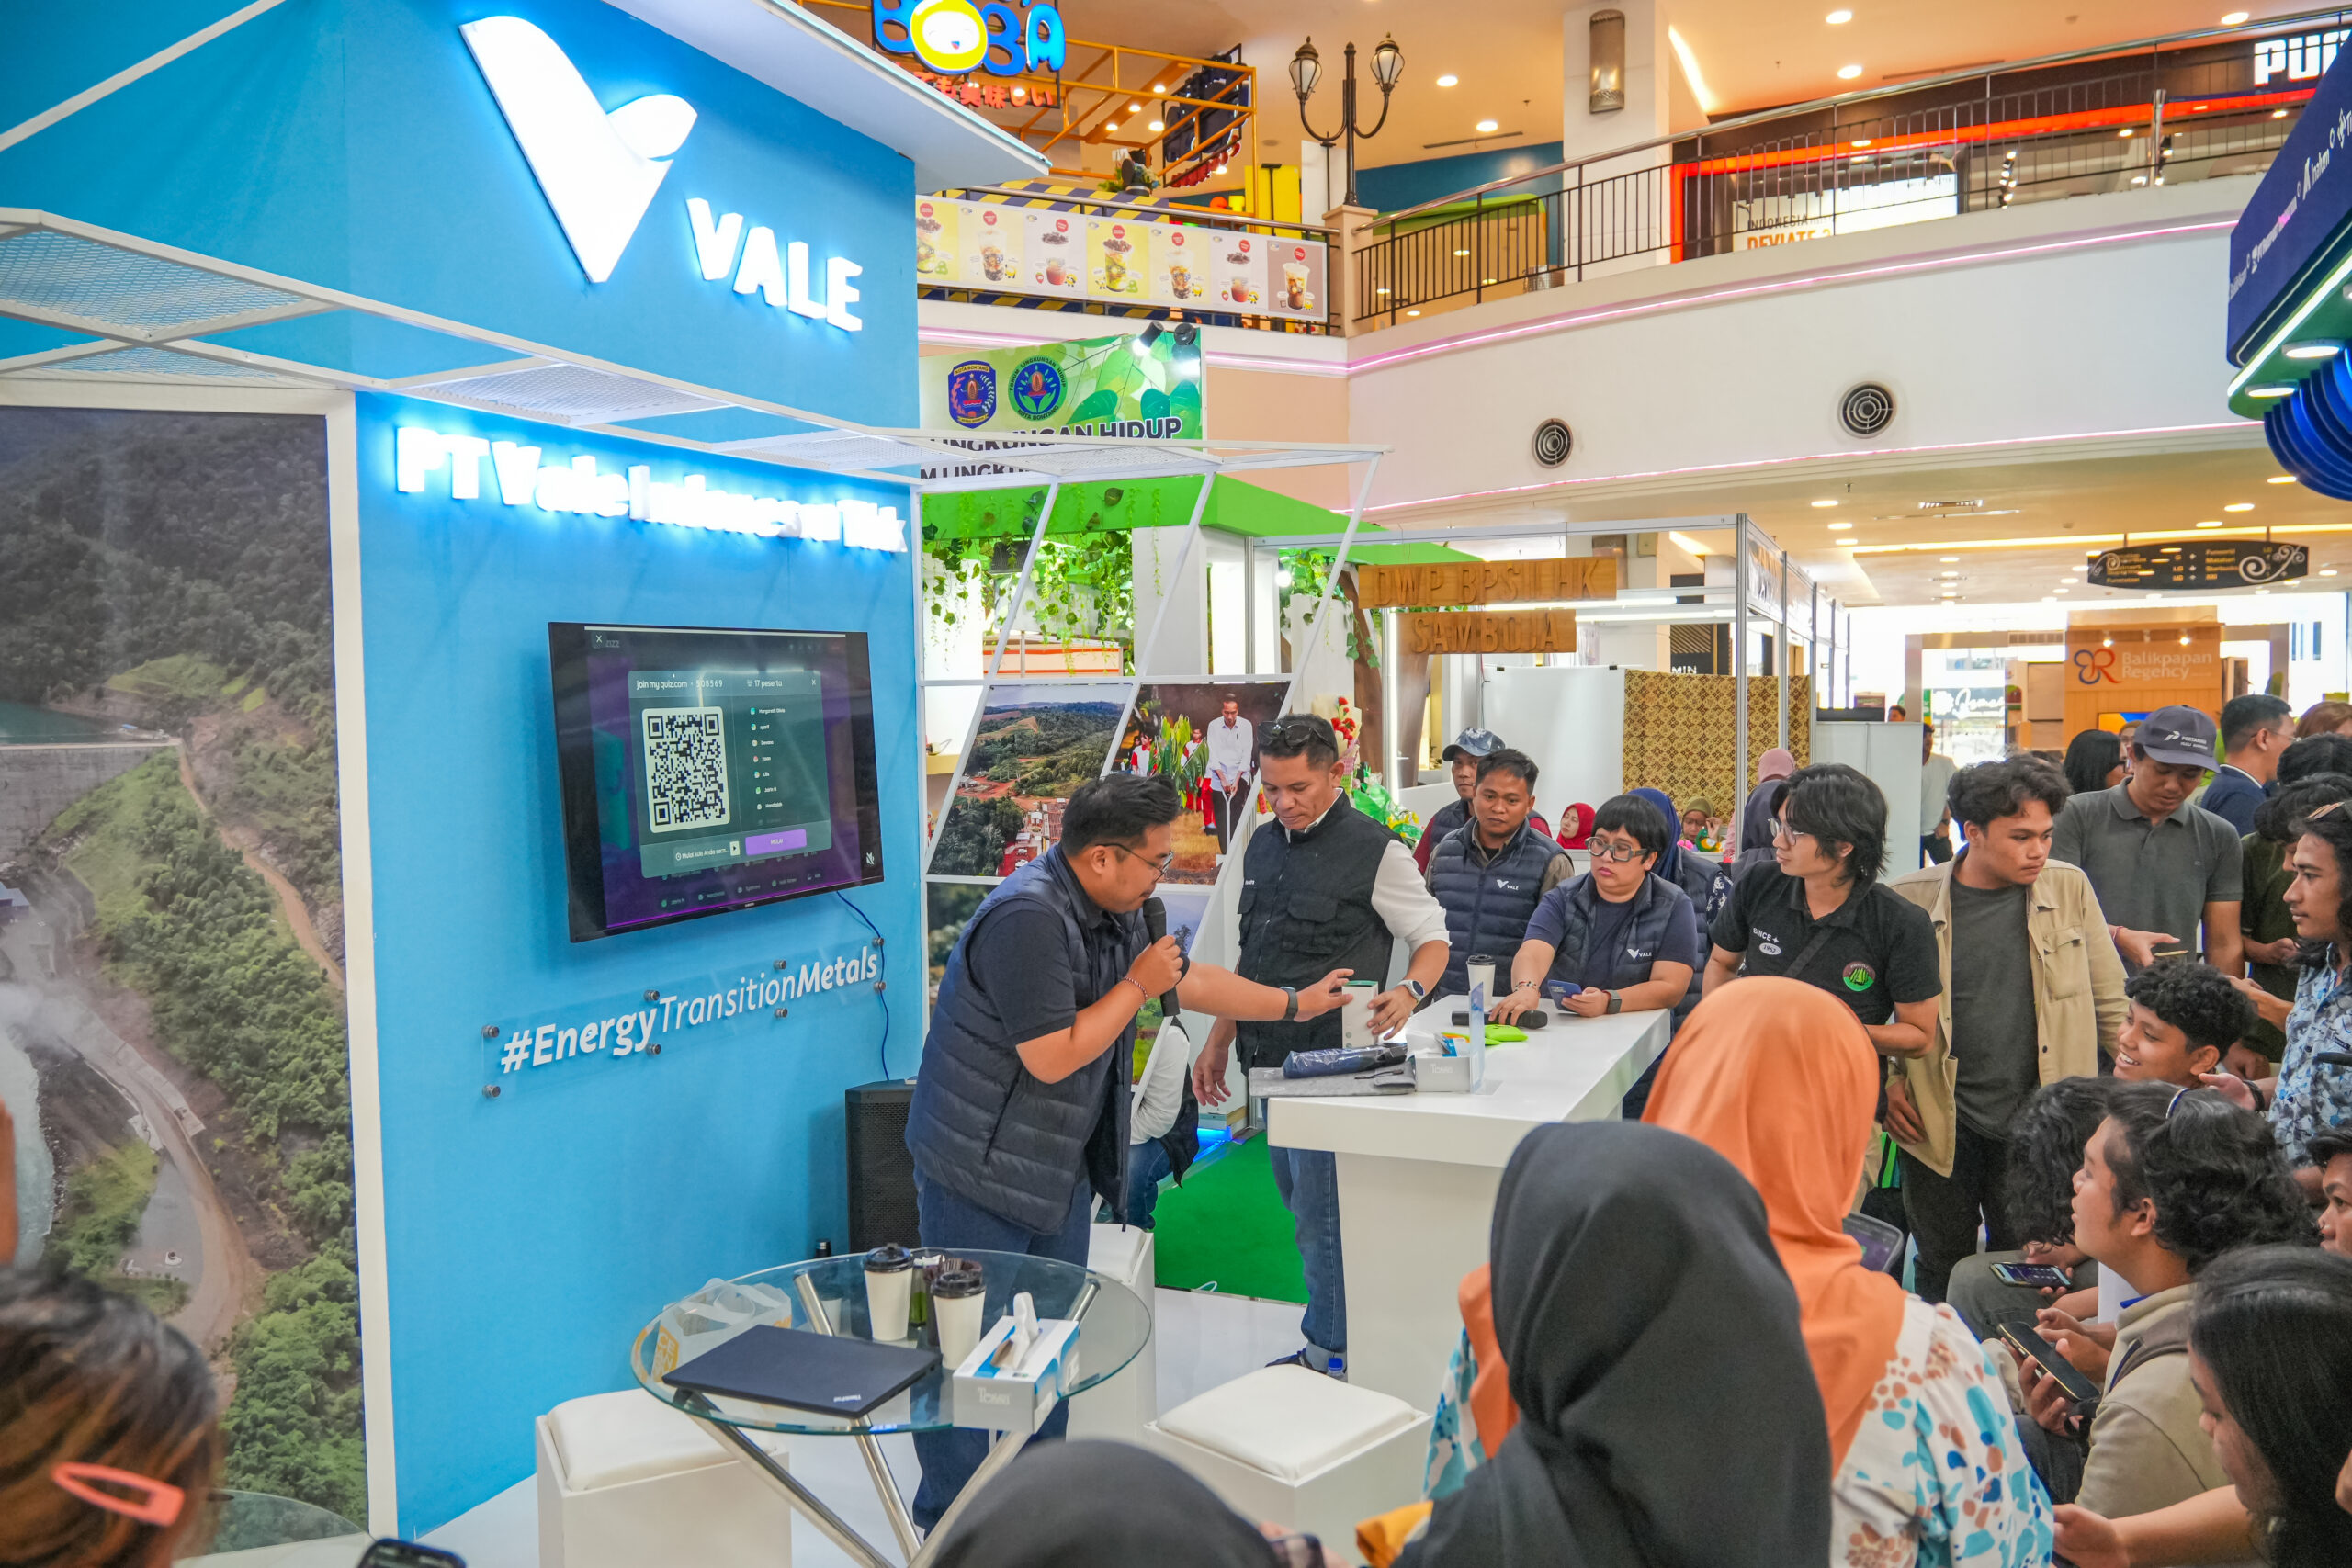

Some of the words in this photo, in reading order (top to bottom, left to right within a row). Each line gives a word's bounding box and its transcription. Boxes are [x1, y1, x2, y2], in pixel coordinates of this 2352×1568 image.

[685, 197, 864, 332] VALE
[1099, 417, 1182, 440] HIDUP
[397, 426, 490, 500] PT
[1373, 564, 1443, 607] DWP
[1411, 612, 1559, 653] SAMBOJA
[2121, 651, 2212, 669] Balikpapan
[761, 680, 783, 689] peserta
[2121, 665, 2190, 682] Regency
[1752, 927, 1772, 942] SINCE
[1762, 943, 1777, 954] 1962
[500, 946, 878, 1075] #EnergyTransitionMetals
